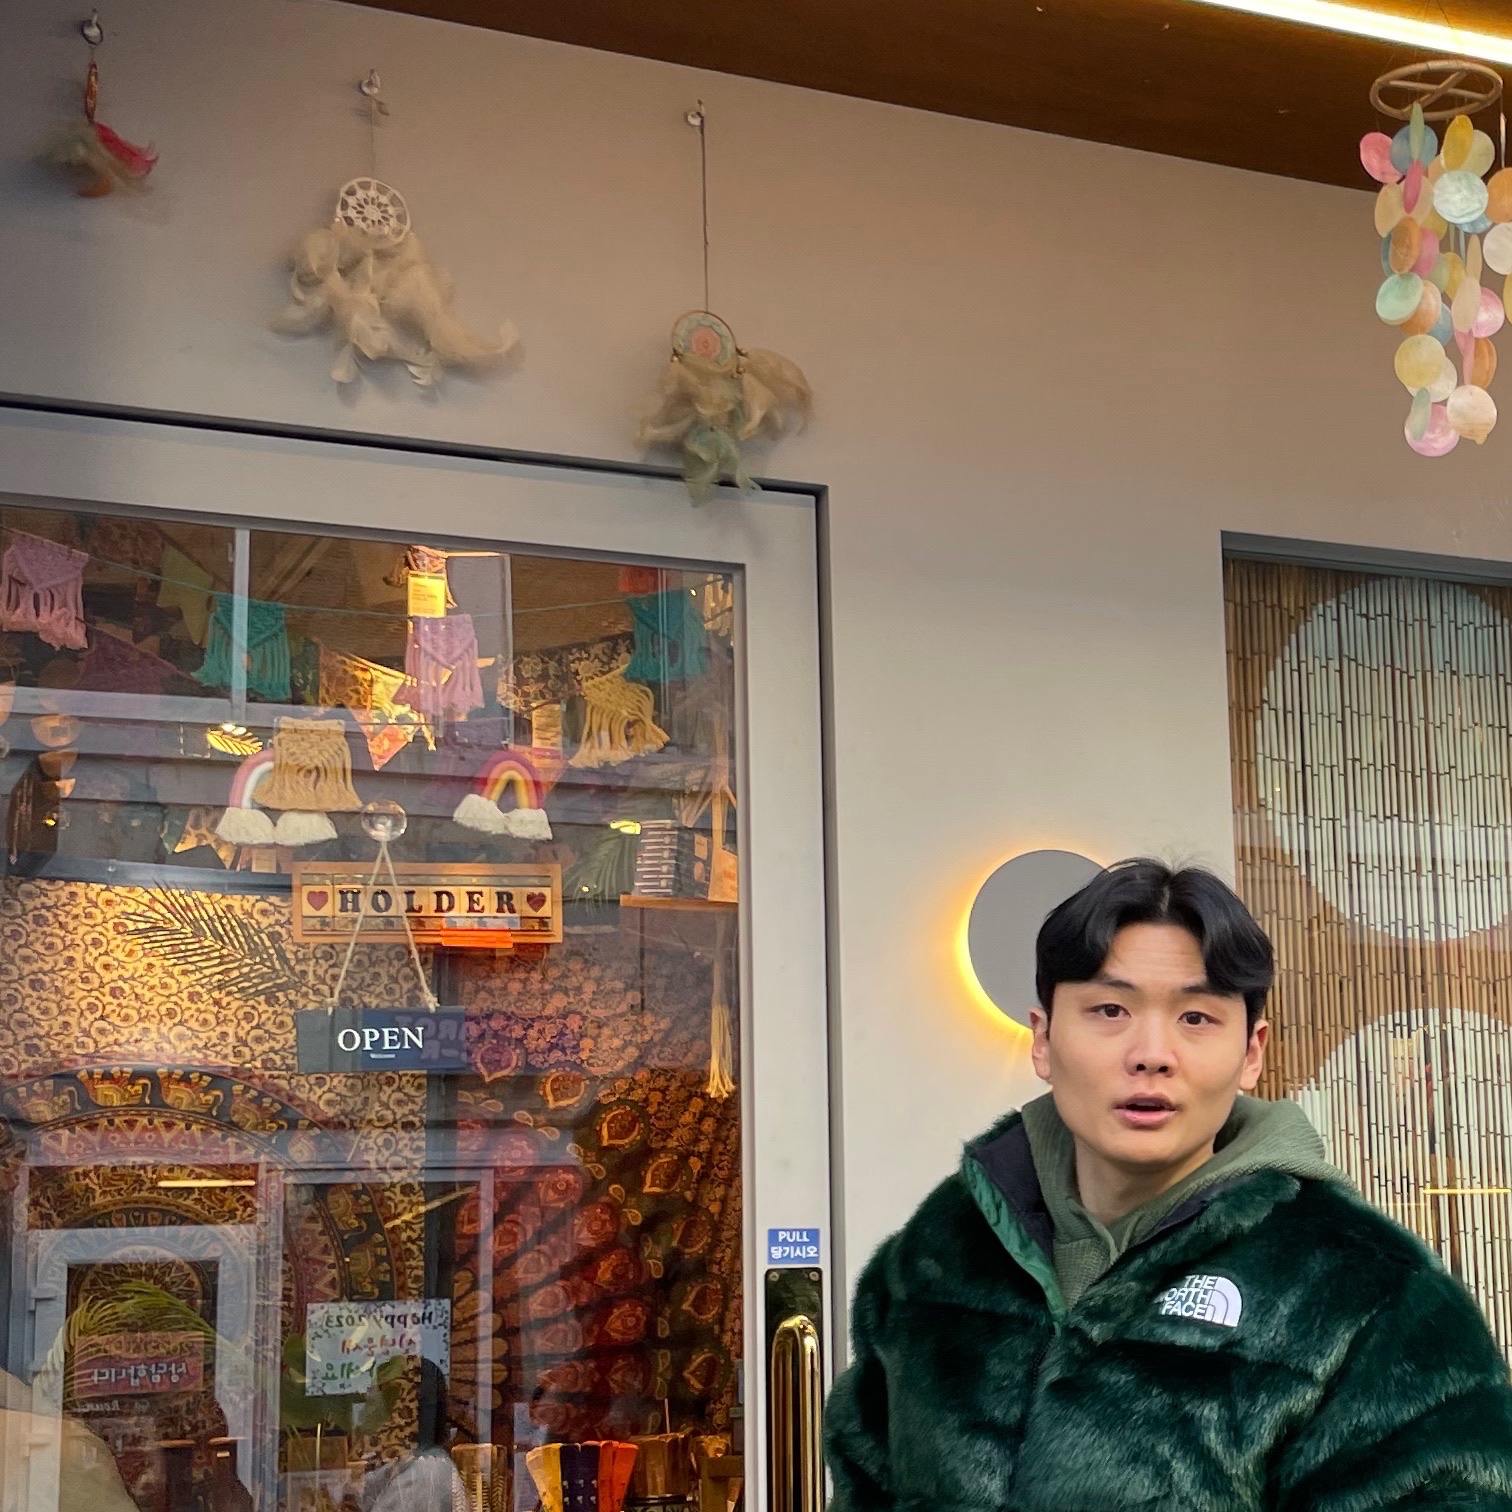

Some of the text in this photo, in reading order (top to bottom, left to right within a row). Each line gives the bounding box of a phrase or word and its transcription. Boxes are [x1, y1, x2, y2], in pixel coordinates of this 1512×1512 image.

[339, 889, 517, 914] HOLDER
[337, 1026, 424, 1052] OPEN
[778, 1231, 810, 1242] PULL
[770, 1246, 819, 1259] 당기시오
[1183, 1274, 1217, 1290] THE
[1161, 1301, 1208, 1320] FACE
